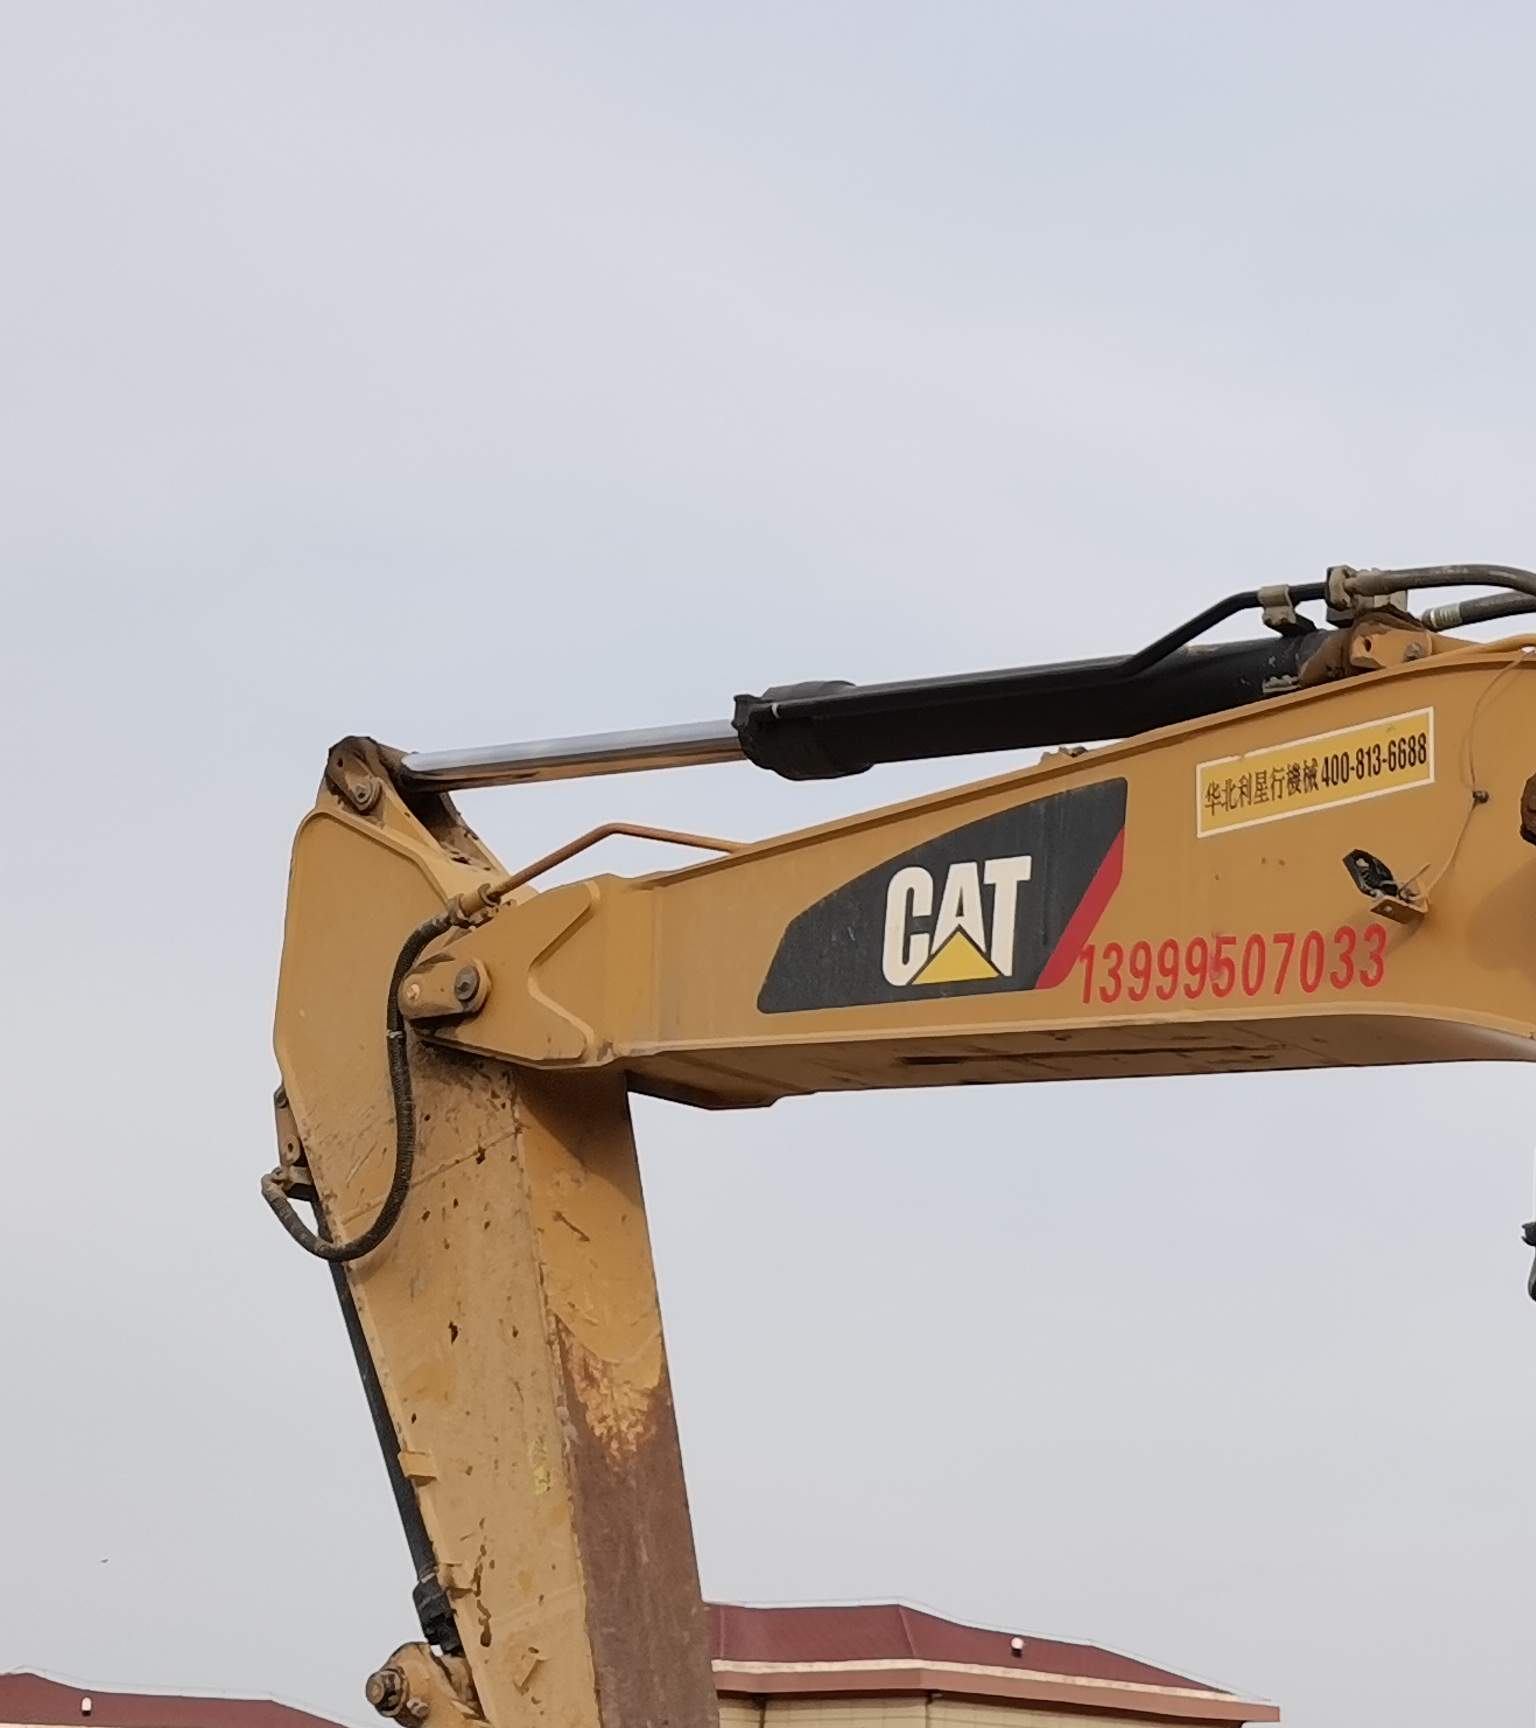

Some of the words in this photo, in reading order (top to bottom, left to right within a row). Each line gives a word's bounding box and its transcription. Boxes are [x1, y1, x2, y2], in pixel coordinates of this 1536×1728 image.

[1321, 732, 1428, 789] 400-813-6688
[882, 855, 1032, 986] CAT
[1079, 923, 1387, 1004] 13999507033
